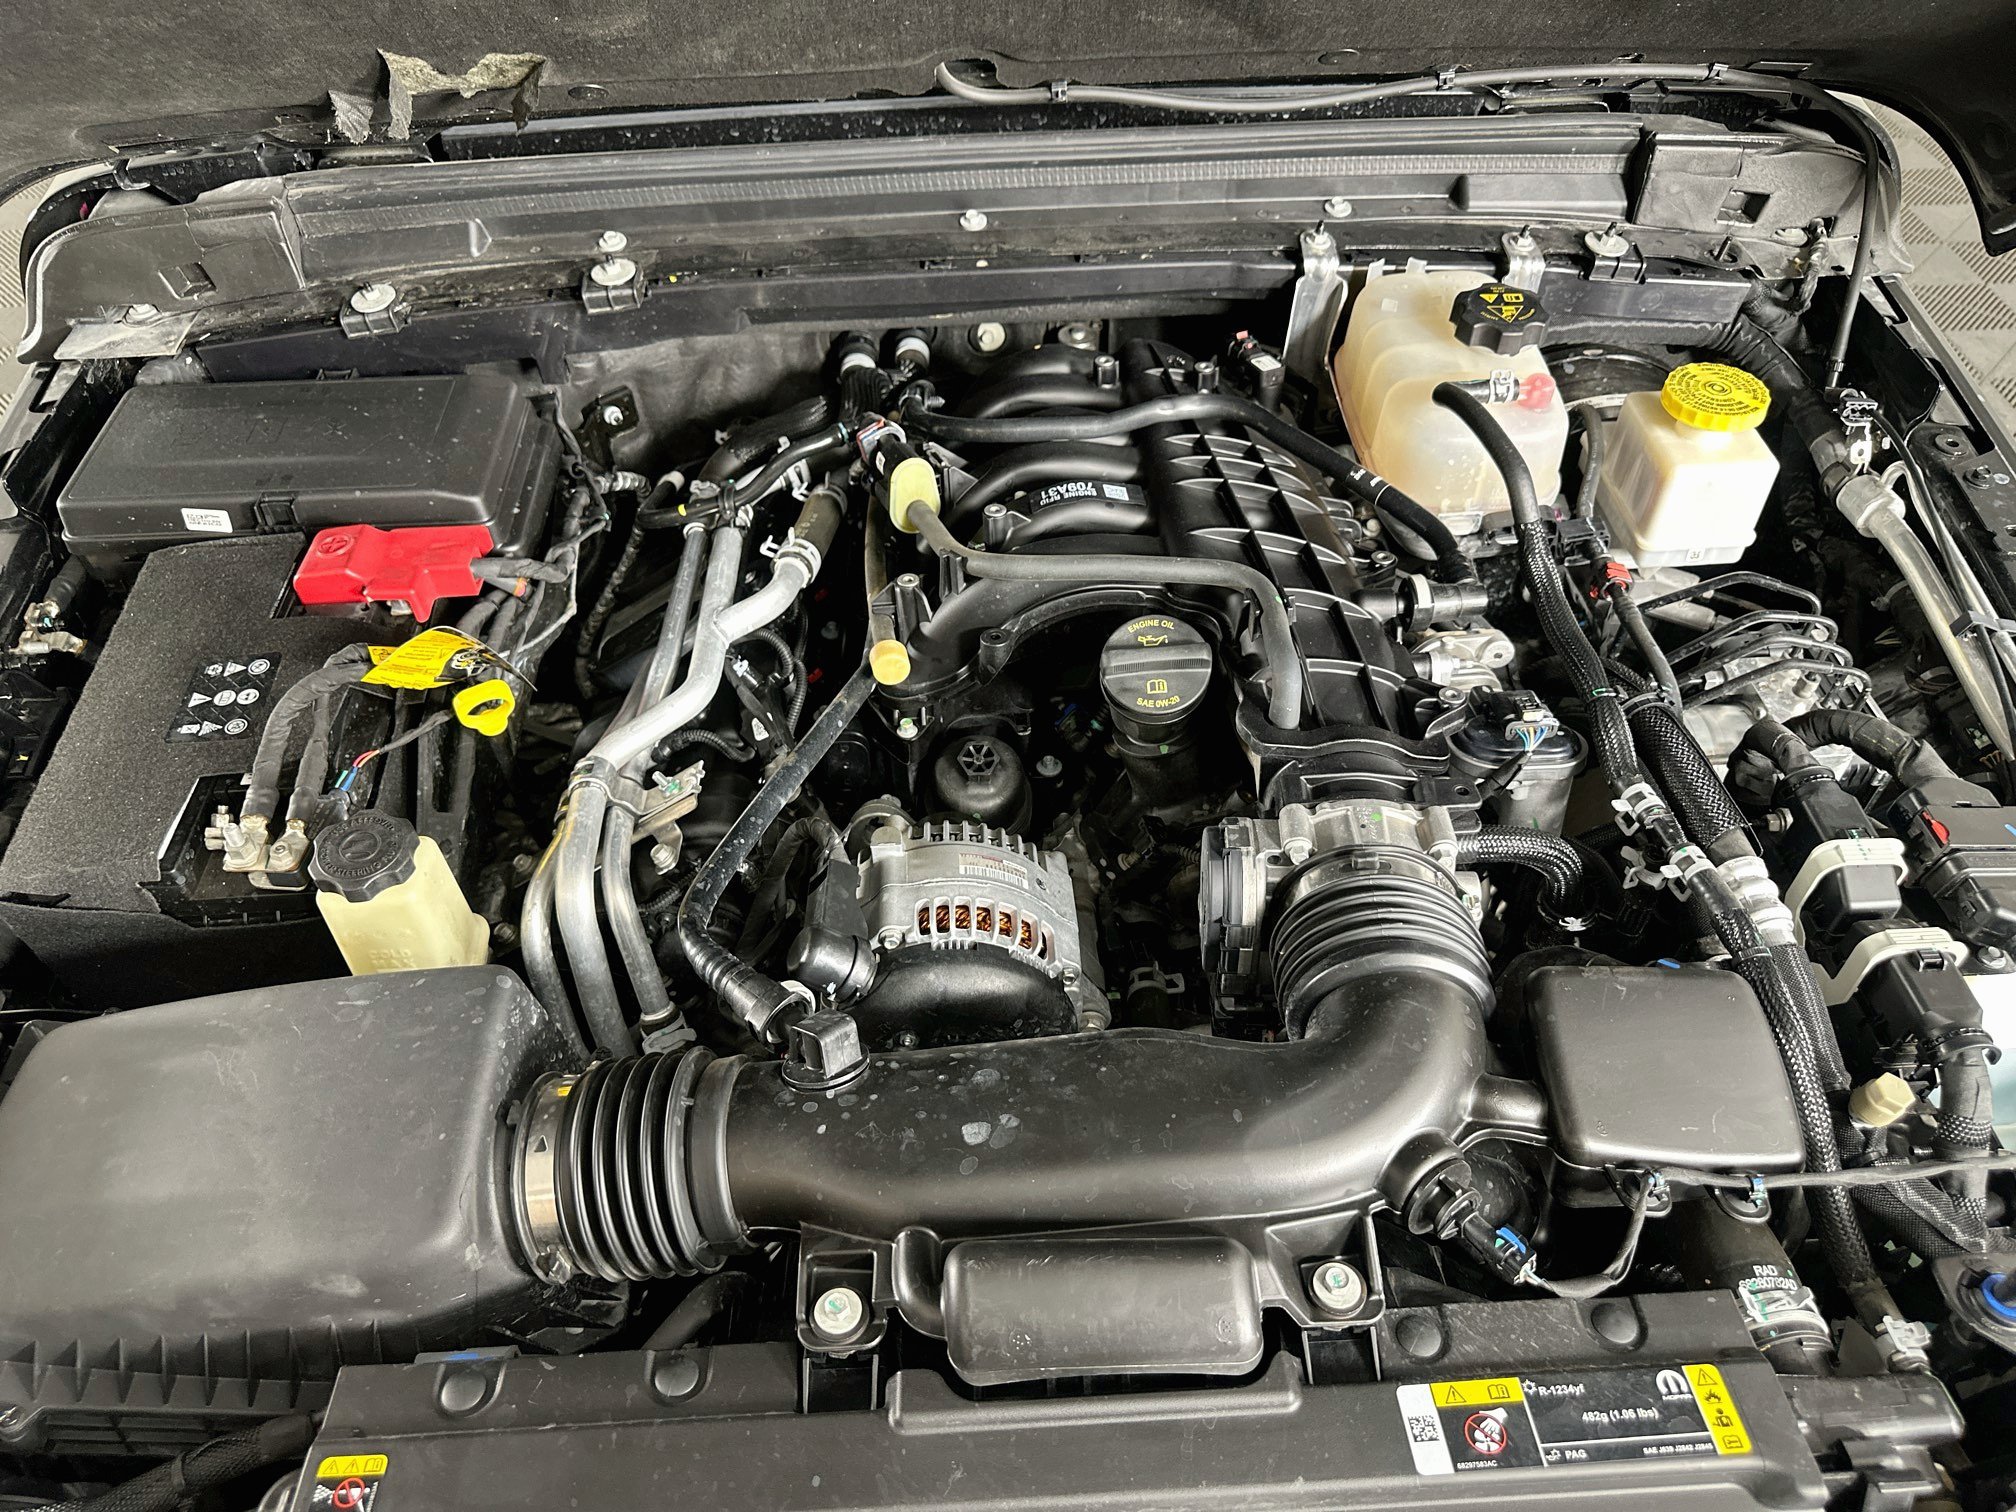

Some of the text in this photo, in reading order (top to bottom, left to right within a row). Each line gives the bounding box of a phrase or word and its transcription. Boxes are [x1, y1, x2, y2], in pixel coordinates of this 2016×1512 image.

[1041, 482, 1093, 500] 709A31
[1064, 488, 1097, 499] ENGINE
[1040, 494, 1061, 506] RFID
[1128, 619, 1174, 632] ENGINE OIL
[1136, 695, 1180, 708] SAE 0W-20
[1753, 1264, 1778, 1276] RAD
[1538, 1384, 1585, 1396] R-1234yf
[1582, 1407, 1660, 1422] 482g (1.06 lbs)
[1564, 1448, 1588, 1460] PAG
